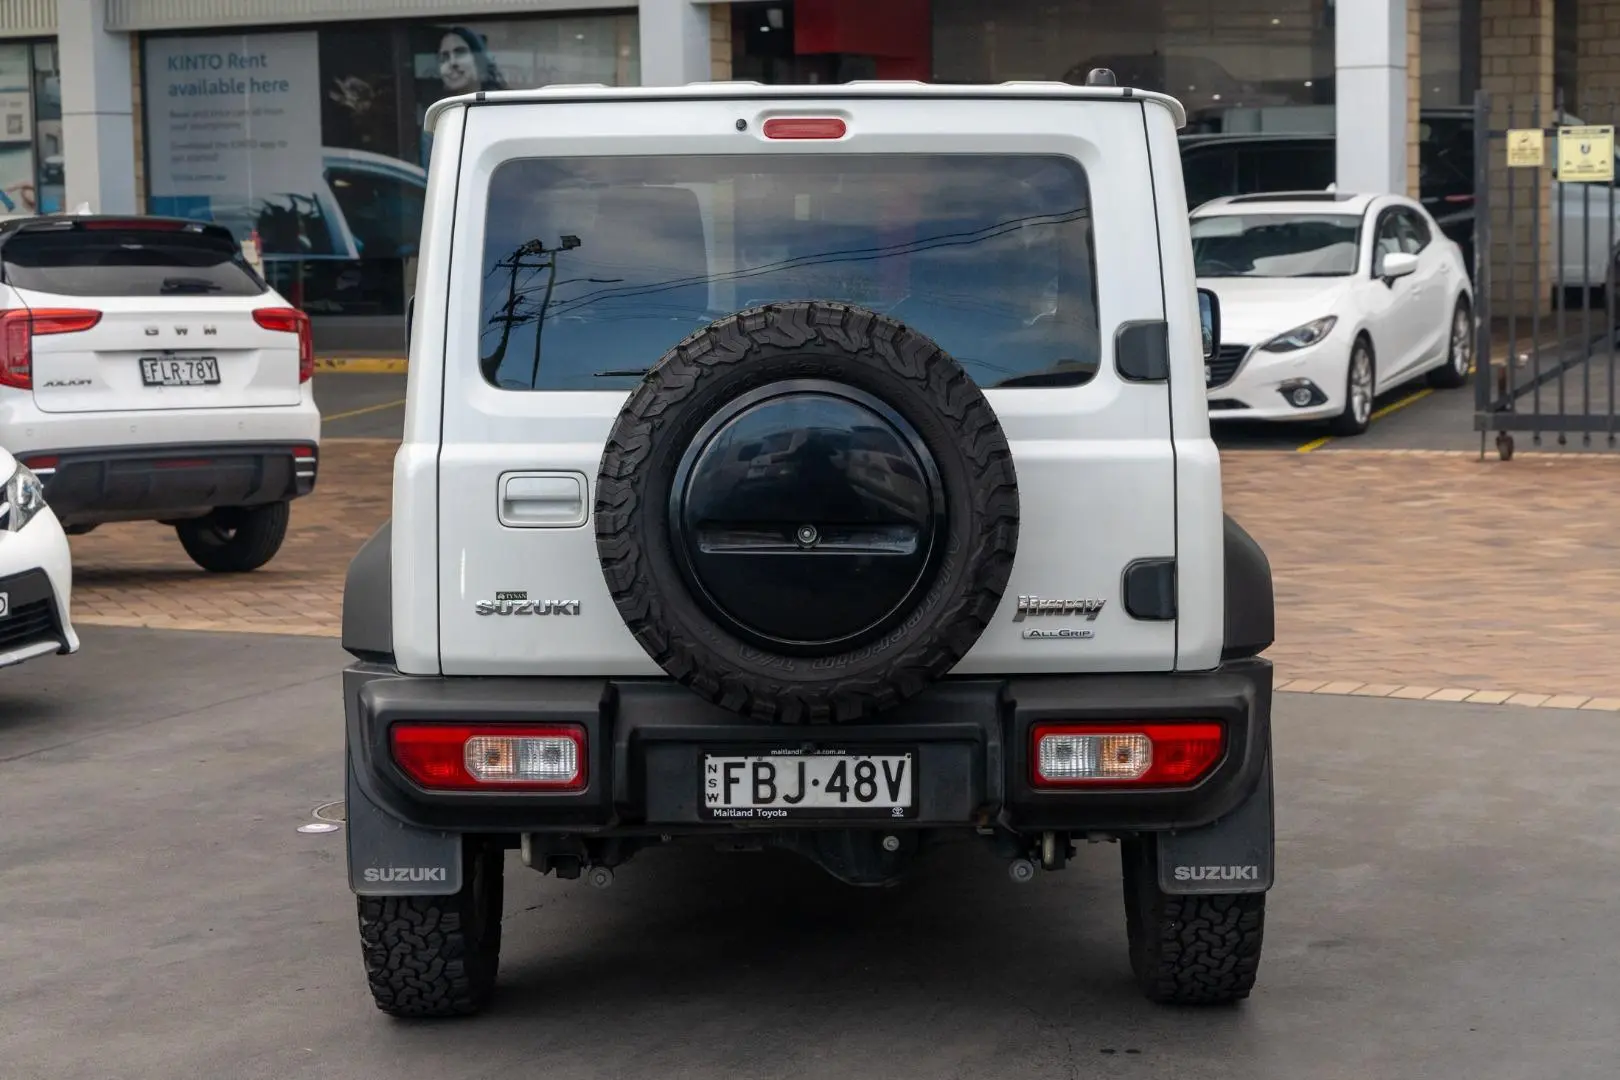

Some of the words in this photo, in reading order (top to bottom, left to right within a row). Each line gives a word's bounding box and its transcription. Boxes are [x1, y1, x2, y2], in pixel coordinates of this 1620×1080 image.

[167, 54, 223, 71] KINTO
[228, 52, 268, 69] Rent
[168, 78, 246, 97] available
[249, 77, 289, 93] here
[475, 599, 581, 616] SUZUKI
[1012, 594, 1107, 622] Jimny
[713, 808, 753, 817] Maitland
[757, 808, 788, 818] Toyota
[363, 867, 446, 882] SUZUKI
[1174, 865, 1258, 881] SUZUKI
